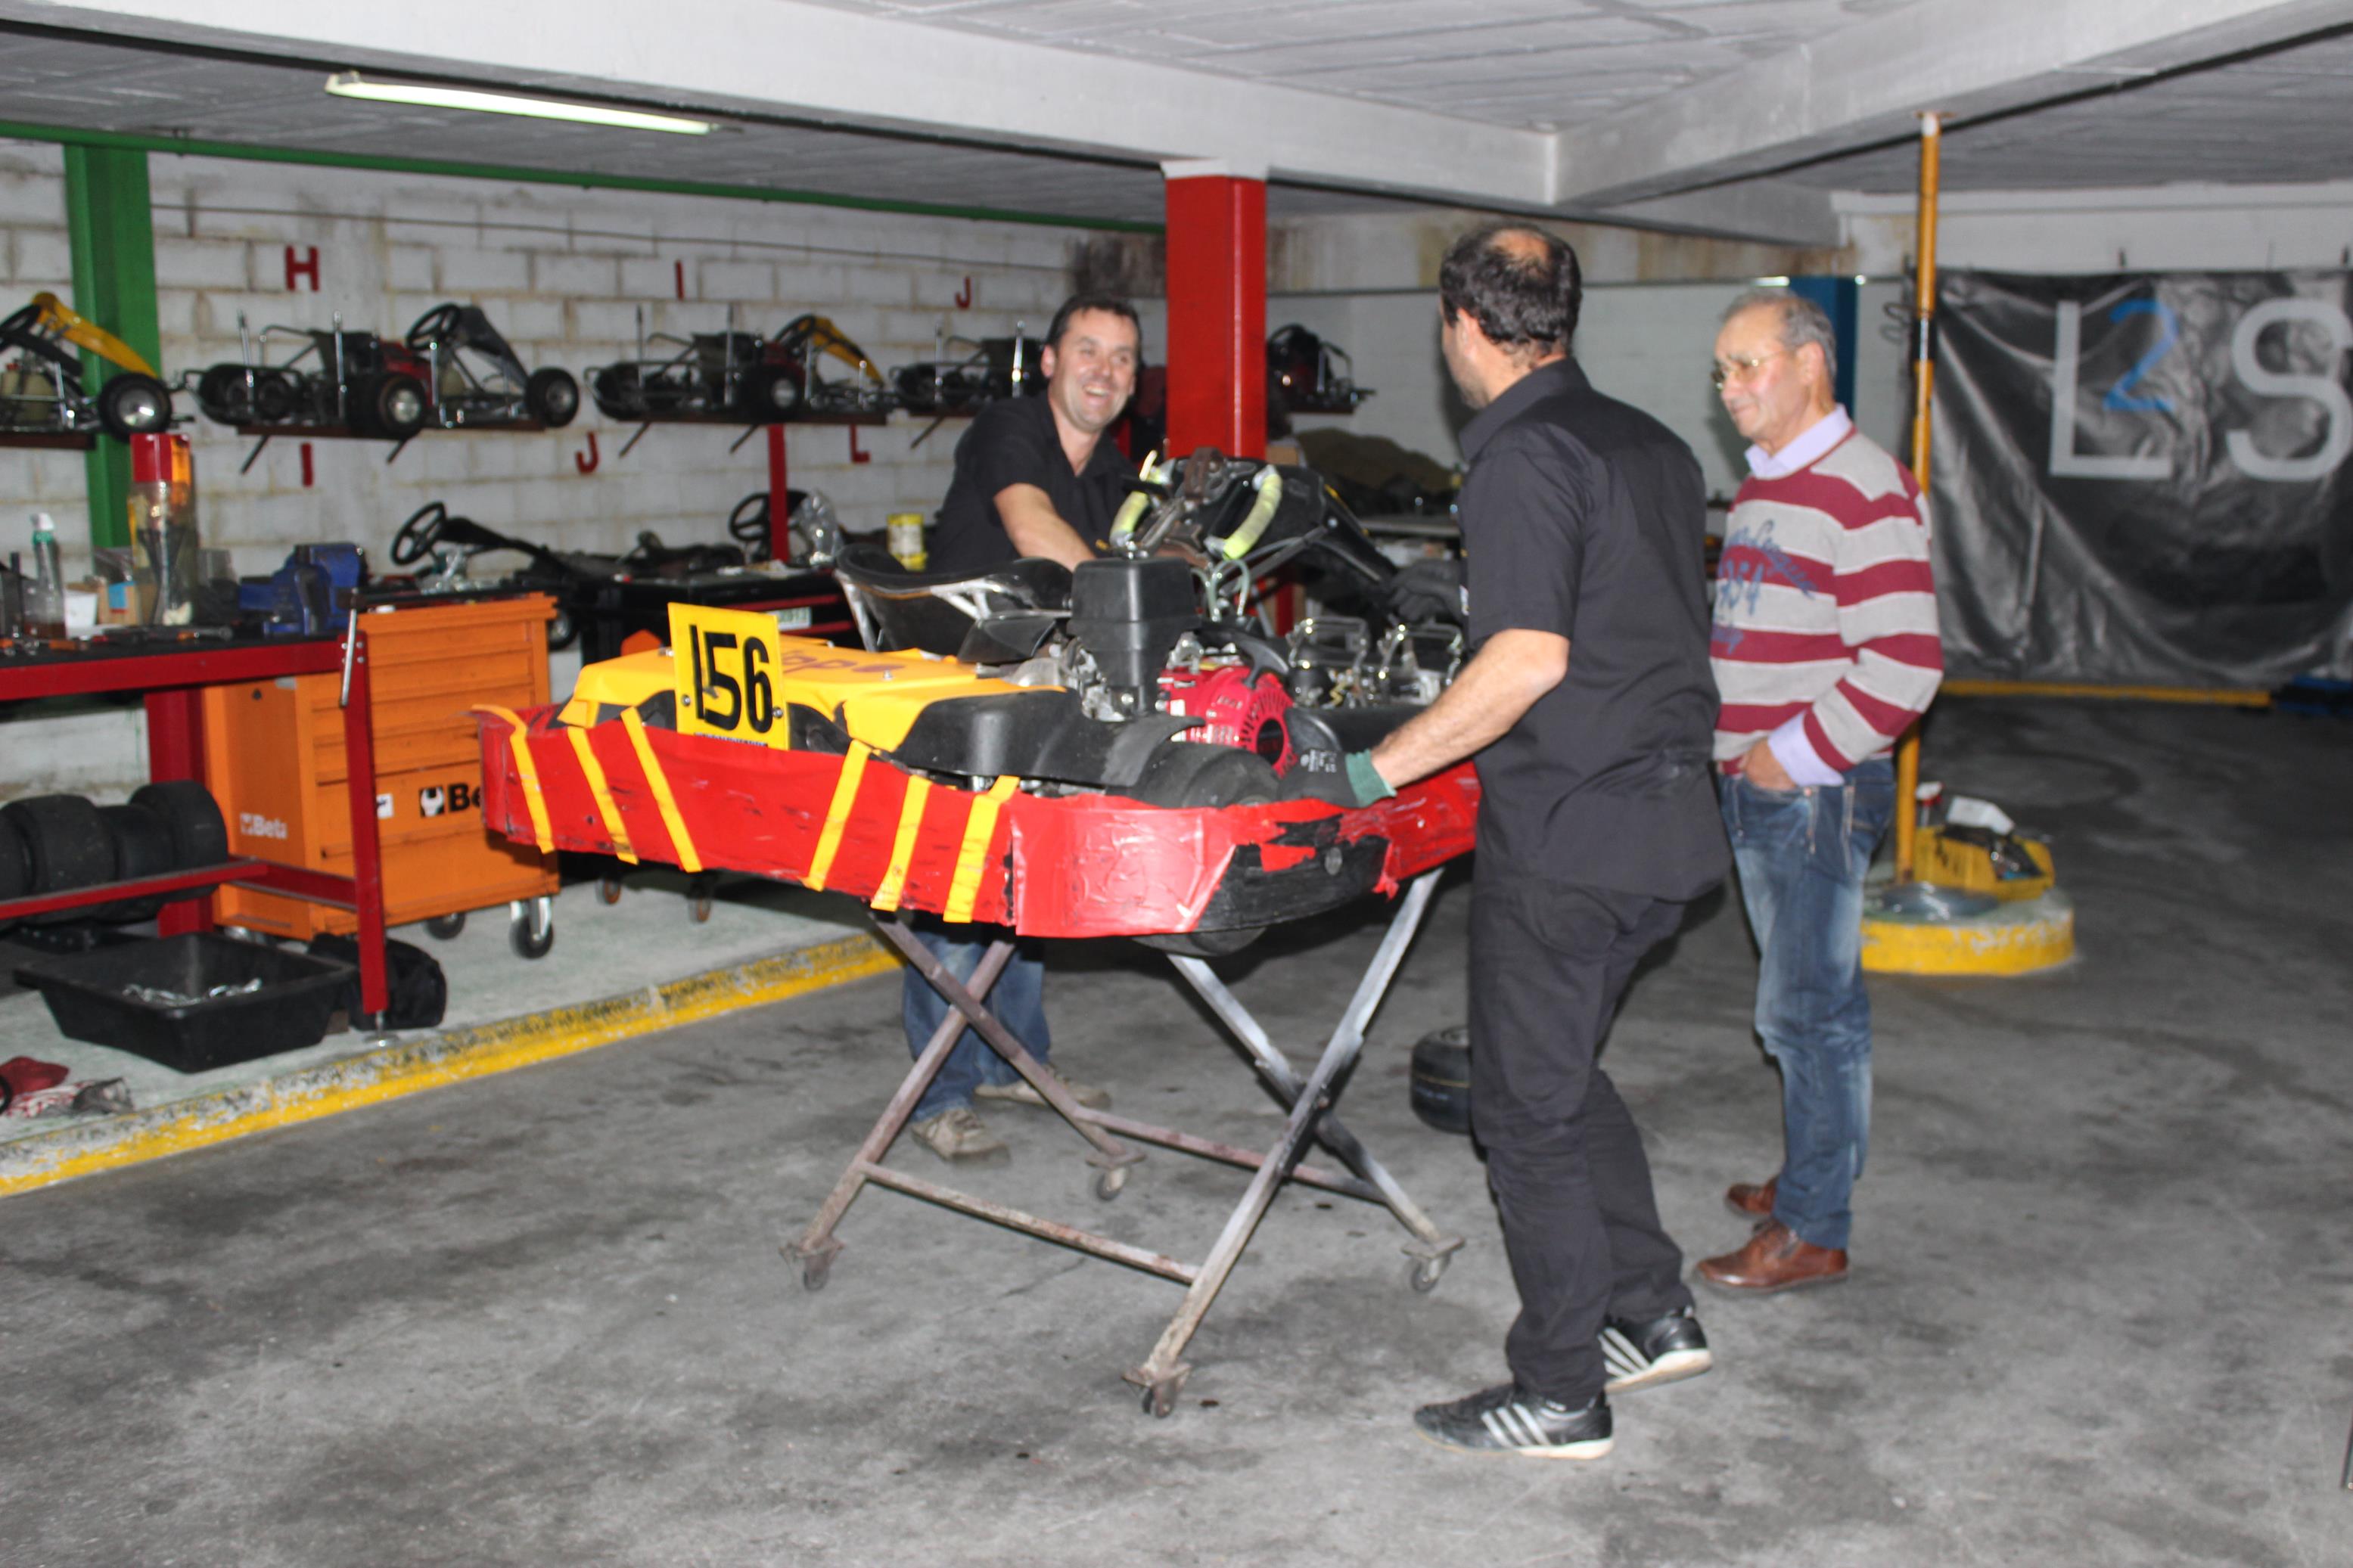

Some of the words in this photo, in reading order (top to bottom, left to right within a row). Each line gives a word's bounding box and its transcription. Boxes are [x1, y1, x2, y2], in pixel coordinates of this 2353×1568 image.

[285, 244, 320, 291] H
[955, 275, 971, 309] J
[575, 430, 600, 475] J
[849, 424, 871, 464] L
[689, 624, 773, 734] 156
